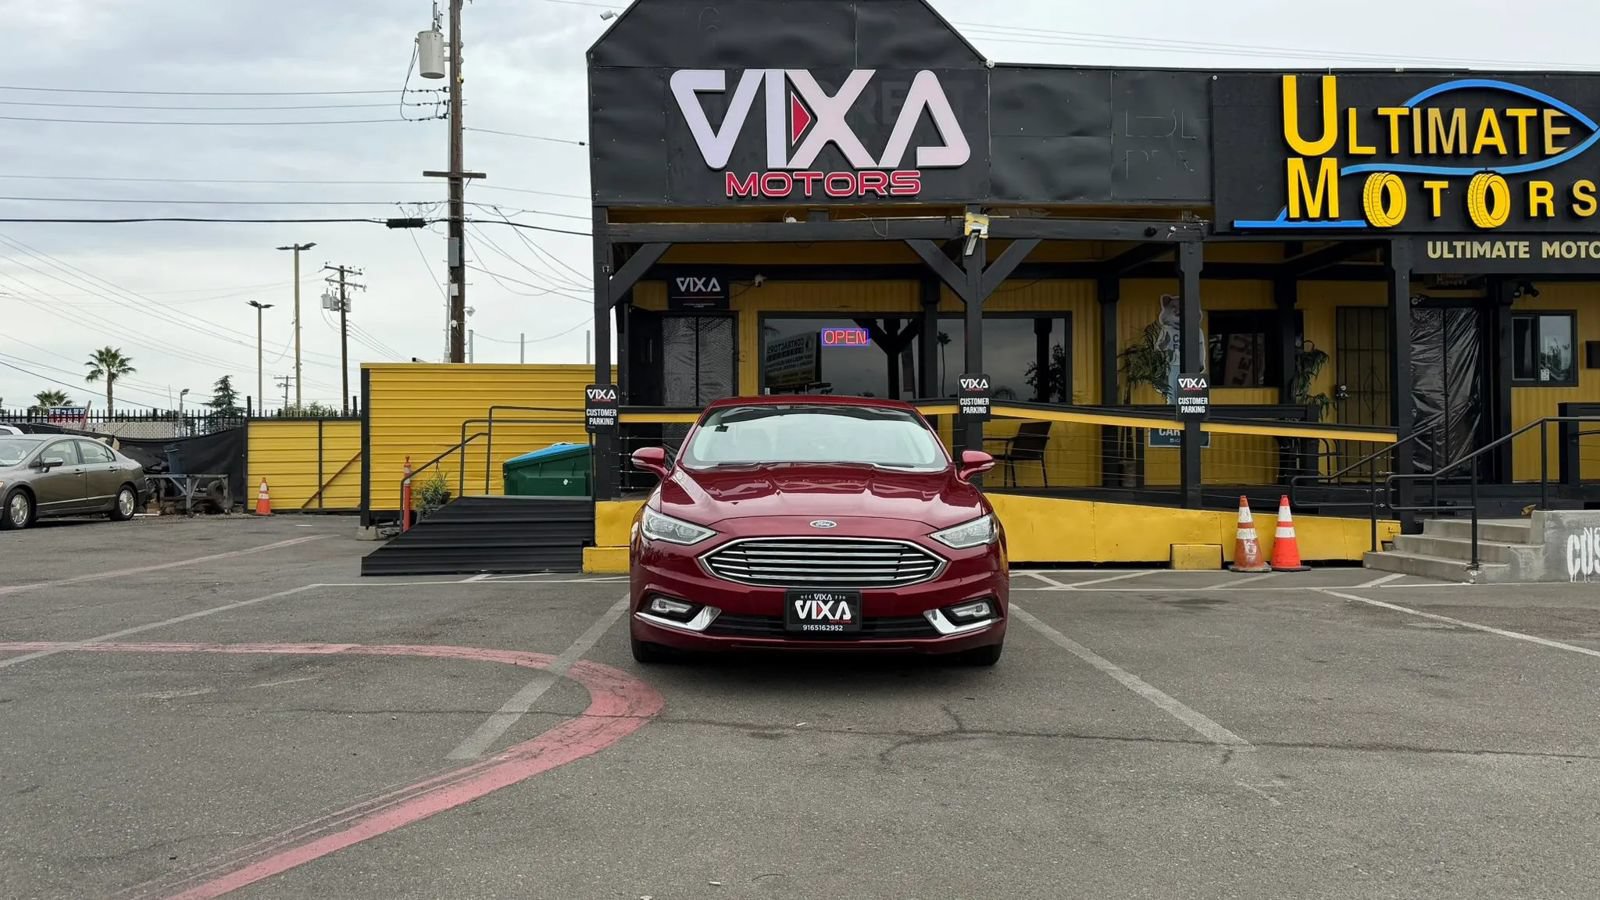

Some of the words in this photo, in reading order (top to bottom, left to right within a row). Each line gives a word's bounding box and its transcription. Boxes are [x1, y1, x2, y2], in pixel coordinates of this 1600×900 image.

[670, 69, 971, 169] VIXA
[1283, 75, 1572, 156] ULTIMATE
[726, 170, 922, 198] MOTORS
[1287, 158, 1598, 229] MOTORS
[1427, 241, 1531, 259] ULTIMATE
[676, 277, 721, 292] VIXA
[823, 330, 867, 344] OPEN
[960, 379, 989, 388] VIXA
[1178, 378, 1207, 388] VIXA
[587, 389, 616, 399] VIXA
[960, 397, 989, 405] CUSTOMER
[1178, 397, 1208, 405] CUSTOMER
[586, 408, 617, 416] CUSTOMER
[963, 406, 987, 414] PARKING
[1181, 405, 1206, 414] PARKING
[589, 417, 614, 425] PARKING
[794, 600, 852, 620] VIXA
